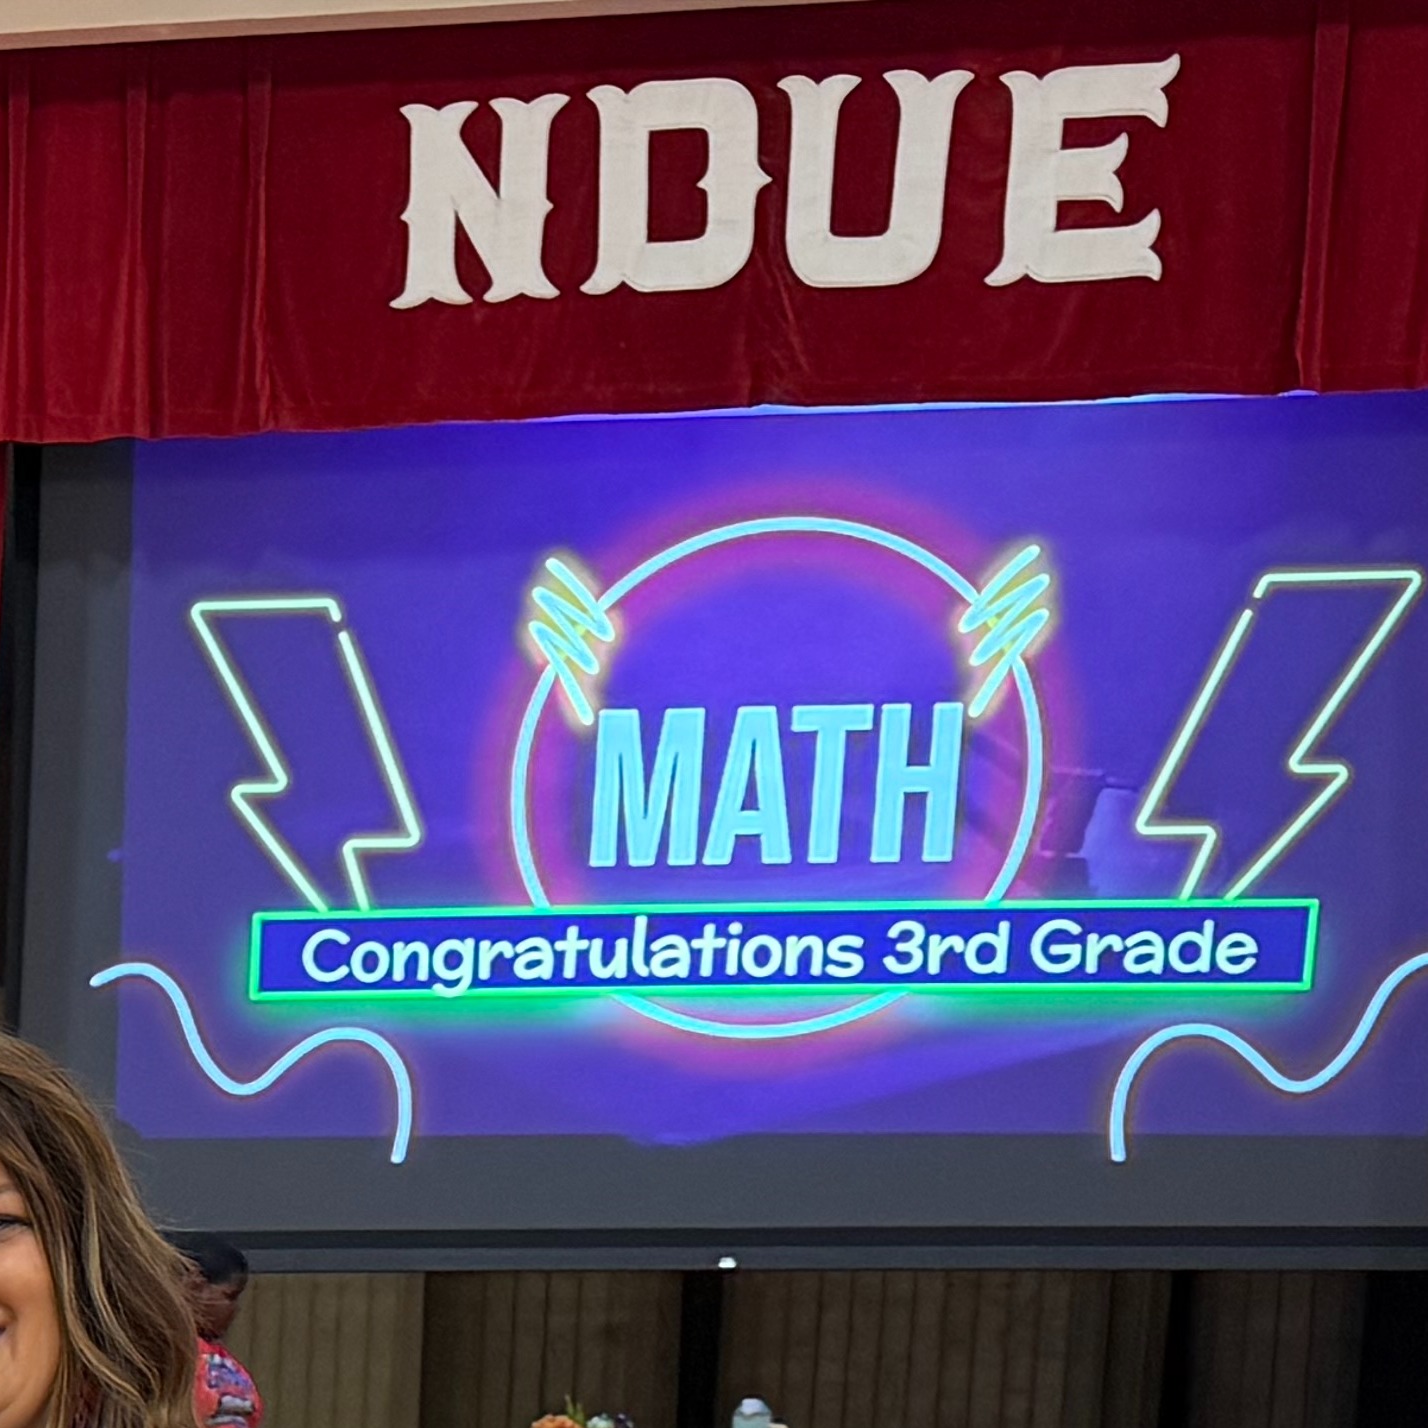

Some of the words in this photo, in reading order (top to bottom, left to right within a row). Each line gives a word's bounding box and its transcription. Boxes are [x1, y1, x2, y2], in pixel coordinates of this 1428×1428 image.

[389, 53, 1181, 310] NDUE
[588, 702, 965, 867] MATH
[300, 917, 864, 998] Congratulations
[884, 916, 1009, 978] 3rd
[1030, 912, 1259, 976] Grade
